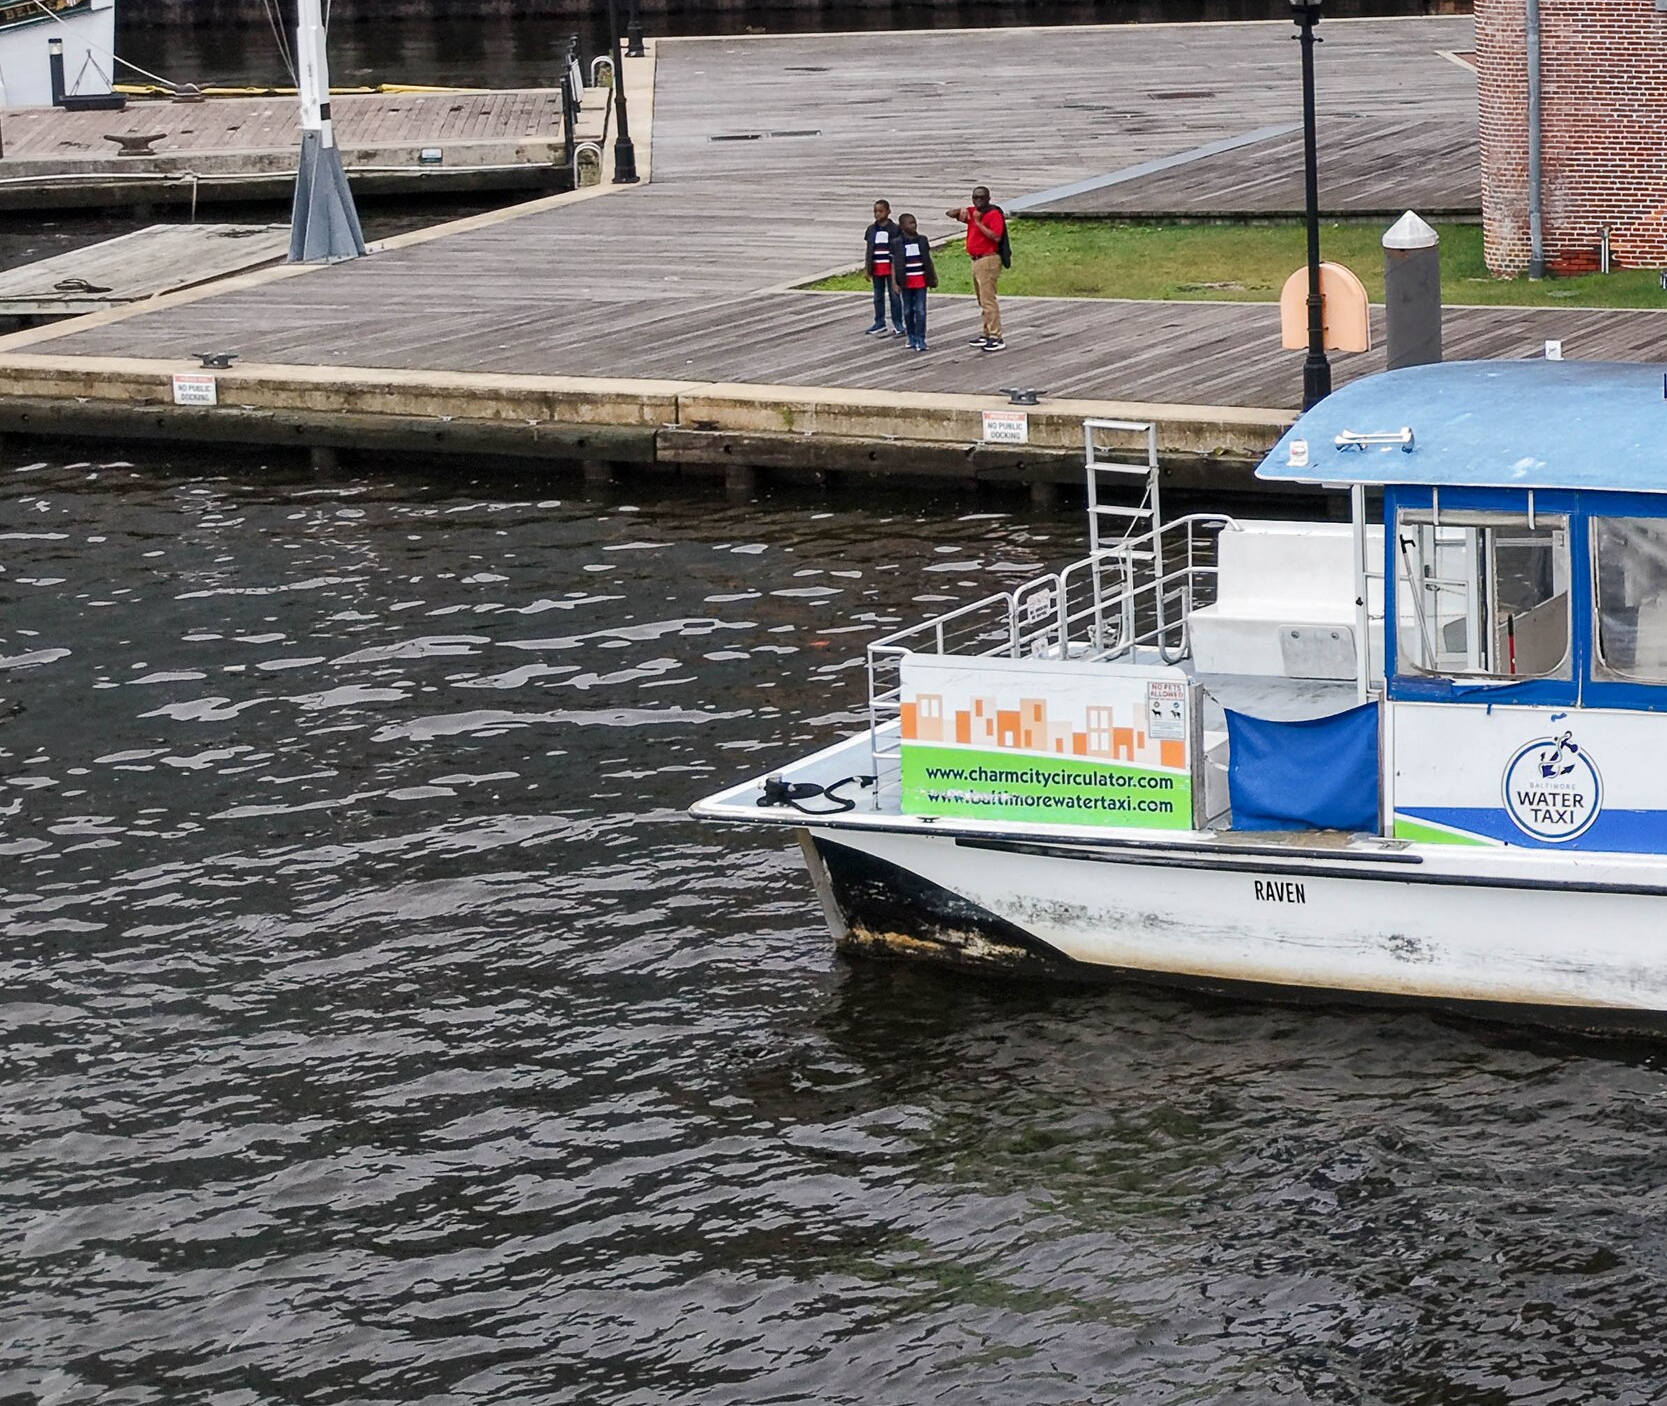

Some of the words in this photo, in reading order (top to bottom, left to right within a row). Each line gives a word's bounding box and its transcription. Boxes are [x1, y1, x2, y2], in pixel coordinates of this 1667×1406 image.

[987, 422, 998, 430] NO
[998, 422, 1022, 431] PUBLIC
[990, 431, 1021, 440] DOCKING
[925, 765, 1174, 790] www.charmcitycirculator.com
[1529, 781, 1576, 791] BALTIMORE
[1516, 790, 1584, 809] WATER
[1530, 808, 1575, 825] TAXI
[1254, 880, 1306, 904] RAVEN
